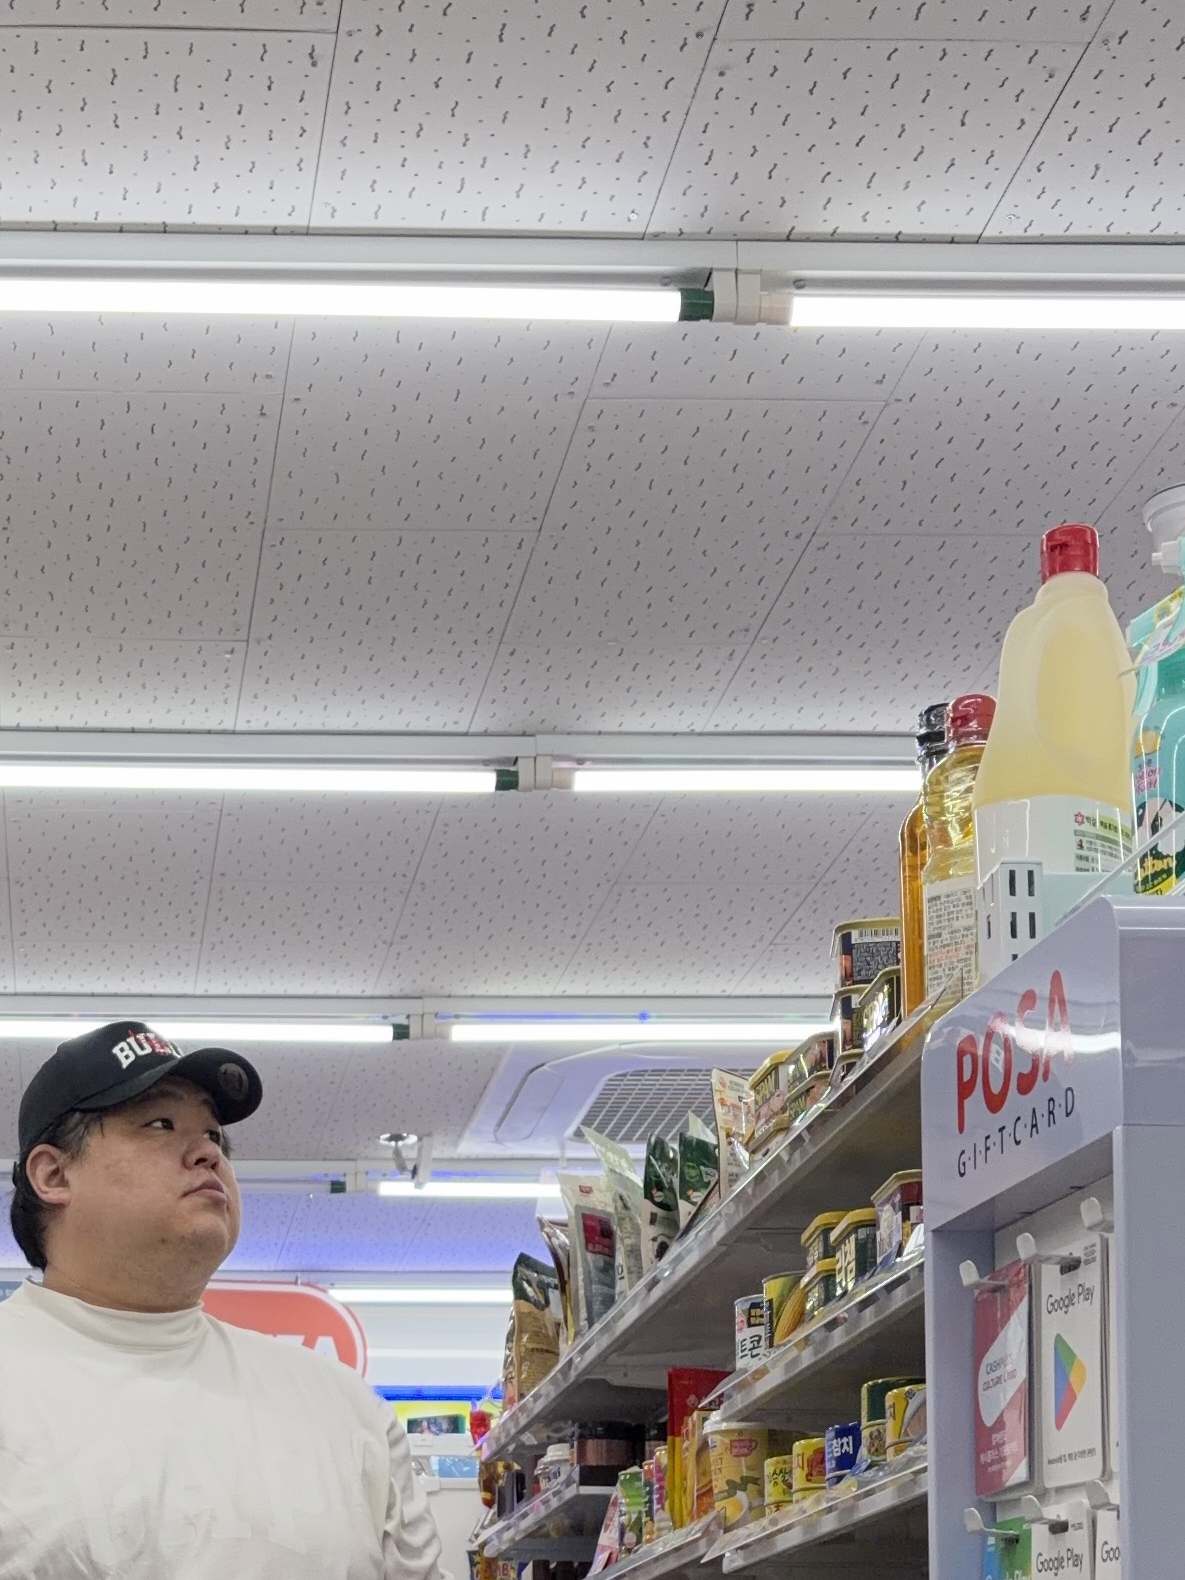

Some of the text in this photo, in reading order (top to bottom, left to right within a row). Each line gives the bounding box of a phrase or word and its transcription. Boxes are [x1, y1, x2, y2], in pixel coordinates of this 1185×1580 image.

[956, 969, 1075, 1135] POSA
[1045, 1281, 1095, 1316] Google Play
[832, 1434, 854, 1457] 참치
[1035, 1547, 1084, 1577] Google Play
[1101, 1540, 1122, 1563] Goo
